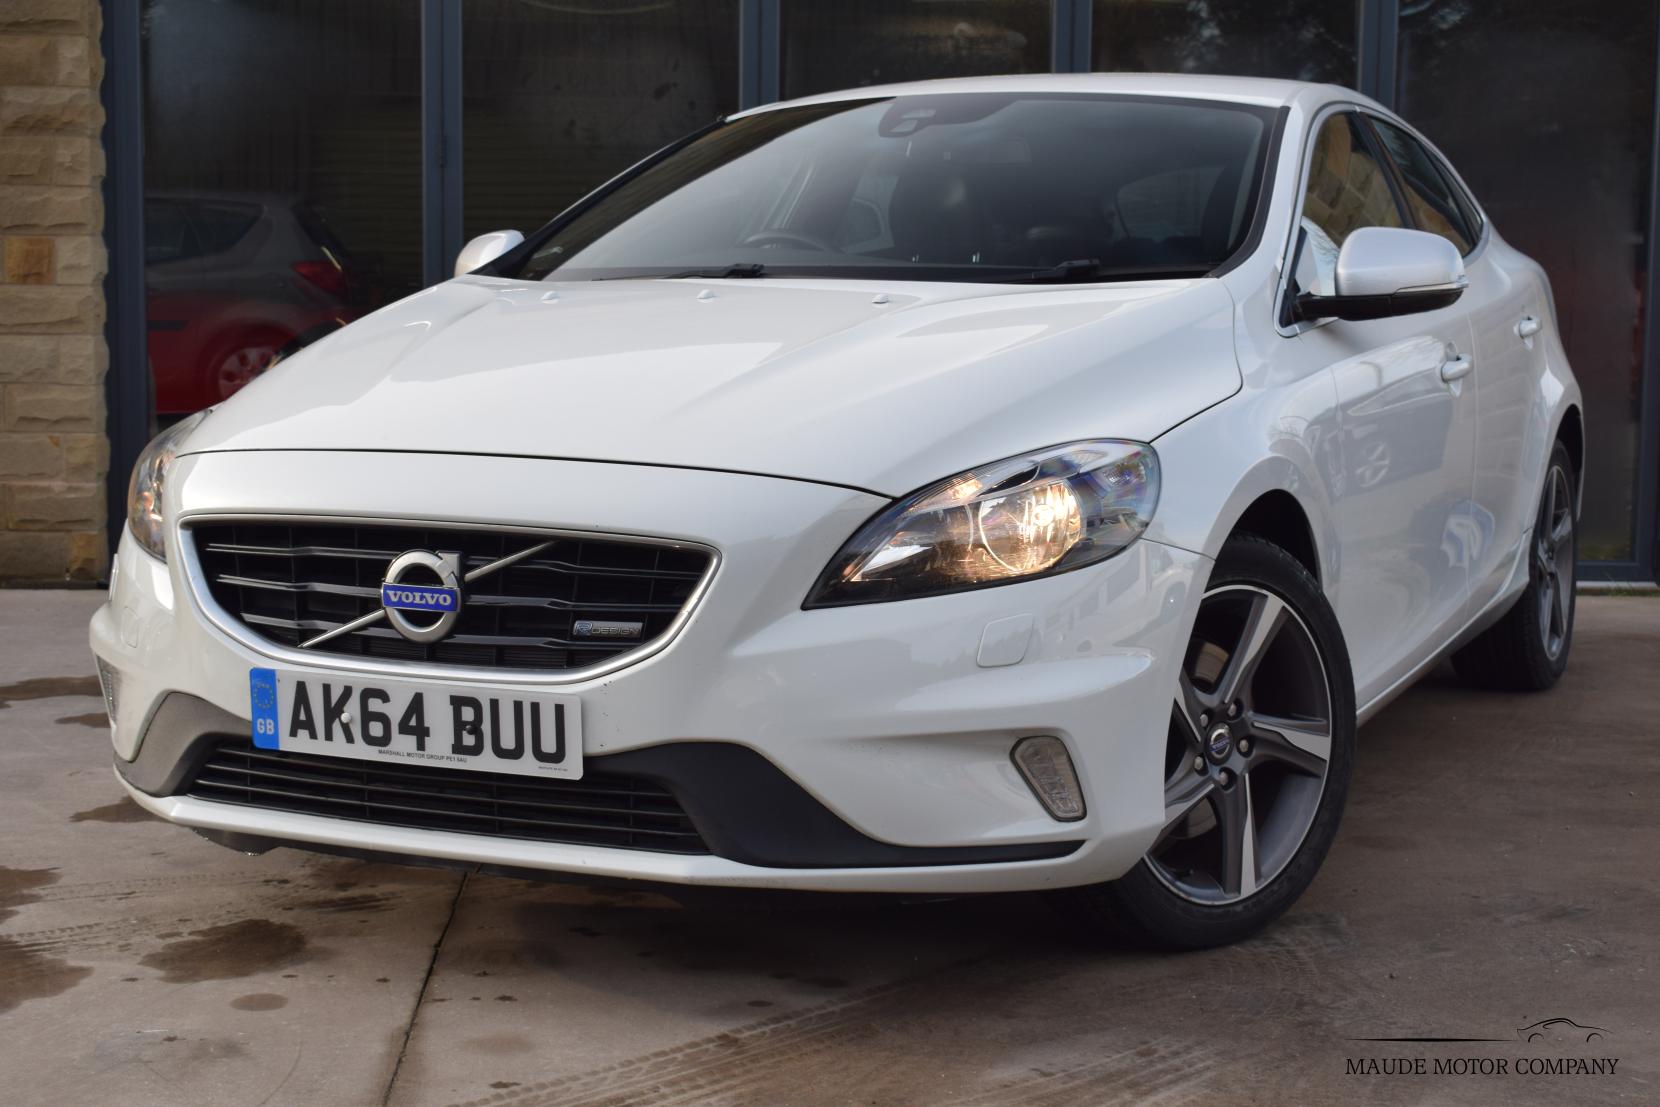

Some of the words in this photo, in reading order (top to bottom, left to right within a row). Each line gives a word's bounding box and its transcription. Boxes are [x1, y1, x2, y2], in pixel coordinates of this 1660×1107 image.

[386, 589, 452, 606] VOLVO
[257, 718, 275, 735] GB
[289, 680, 430, 752] AK64
[449, 695, 566, 764] BUU
[378, 749, 405, 757] MARSHALL
